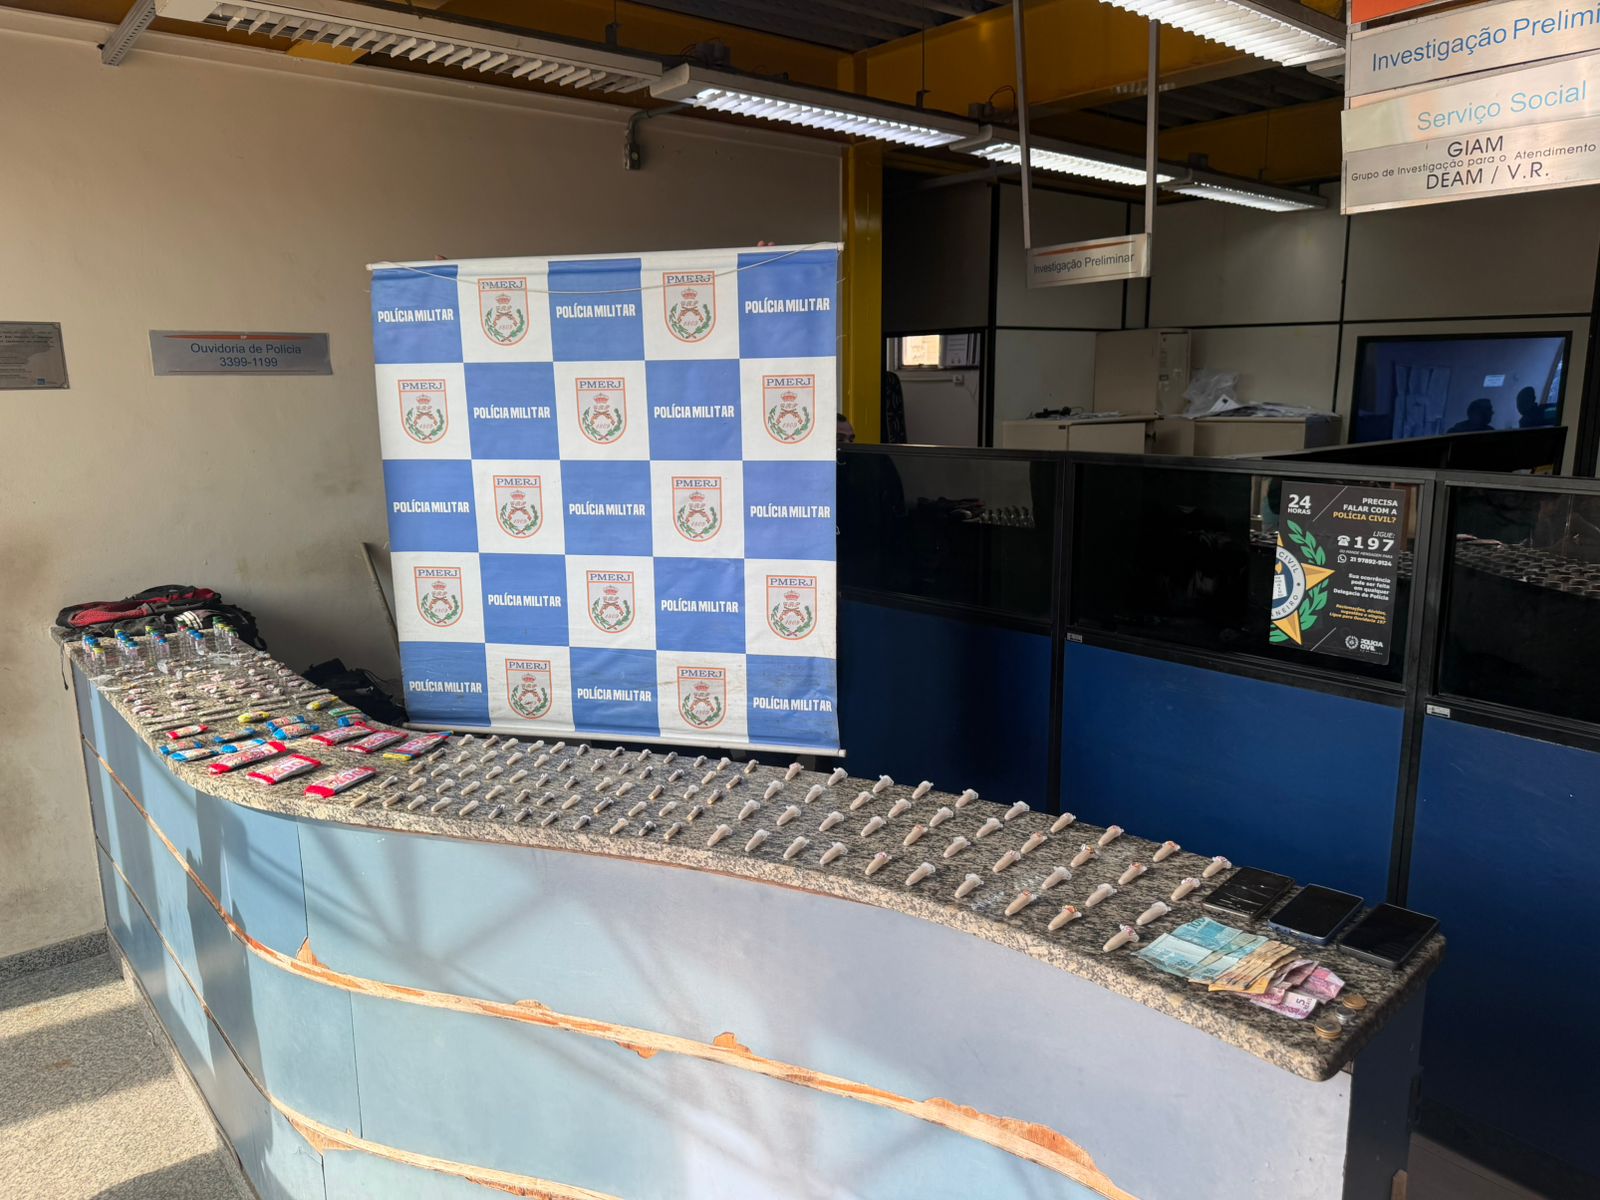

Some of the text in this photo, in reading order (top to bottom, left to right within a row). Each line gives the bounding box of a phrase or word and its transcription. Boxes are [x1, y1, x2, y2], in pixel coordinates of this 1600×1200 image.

[1372, 27, 1507, 72] Investigação
[1417, 80, 1587, 131] Serviço Social
[1447, 135, 1504, 158] GIAM
[1351, 143, 1597, 182] Grupo de Investigação para o Atendimento
[1426, 168, 1483, 190] DEAM
[1507, 161, 1549, 180] V.R.
[1033, 253, 1135, 274] Investigação Preliminar
[481, 280, 524, 290] PMERJ
[556, 302, 635, 318] POLÍCIA MILITAR
[745, 298, 830, 314] POLÍCIA MILITAR
[378, 307, 454, 322] POLÍCIA MILITAR
[190, 343, 246, 354] Ouvidoria
[248, 344, 263, 354] de
[220, 357, 278, 368] 3399-1199
[401, 382, 443, 390] PMERJ
[579, 381, 622, 389] PMERJ
[766, 378, 811, 386] PMERJ
[473, 405, 551, 419] POLÍCIA MILITAR
[654, 404, 735, 419] POLÍCIA MILITAR
[496, 478, 538, 486] PMERJ
[675, 480, 718, 488] PMERJ
[393, 499, 469, 513] POLÍCIA MILITAR
[1288, 494, 1311, 508] 24
[1362, 497, 1398, 507] PRECISA
[569, 502, 645, 516] POLÍCIA MILITAR
[751, 503, 831, 518] POLÍCIA MILITAR
[1287, 507, 1311, 515] HORAS
[1343, 504, 1369, 513] FALAR
[1371, 507, 1389, 515] COM
[1333, 511, 1397, 524] POLÍCIA CIVIL?
[1372, 531, 1396, 539] LIGUE:
[1353, 536, 1395, 552] 197
[1278, 551, 1299, 574] CIVIL
[417, 569, 458, 577] PMERJ
[590, 573, 631, 581] PMERJ
[770, 578, 814, 586] PMERJ
[1363, 587, 1390, 595] qualquer
[488, 593, 562, 607] POLÍCIA MILITAR
[661, 598, 739, 613] POLÍCIA MILITAR
[508, 662, 548, 670] PMERJ
[409, 679, 483, 693] POLÍCIA MILITAR
[577, 686, 651, 702] POLÍCIA MILITAR
[753, 698, 832, 712] POLÍCIA MILITAR
